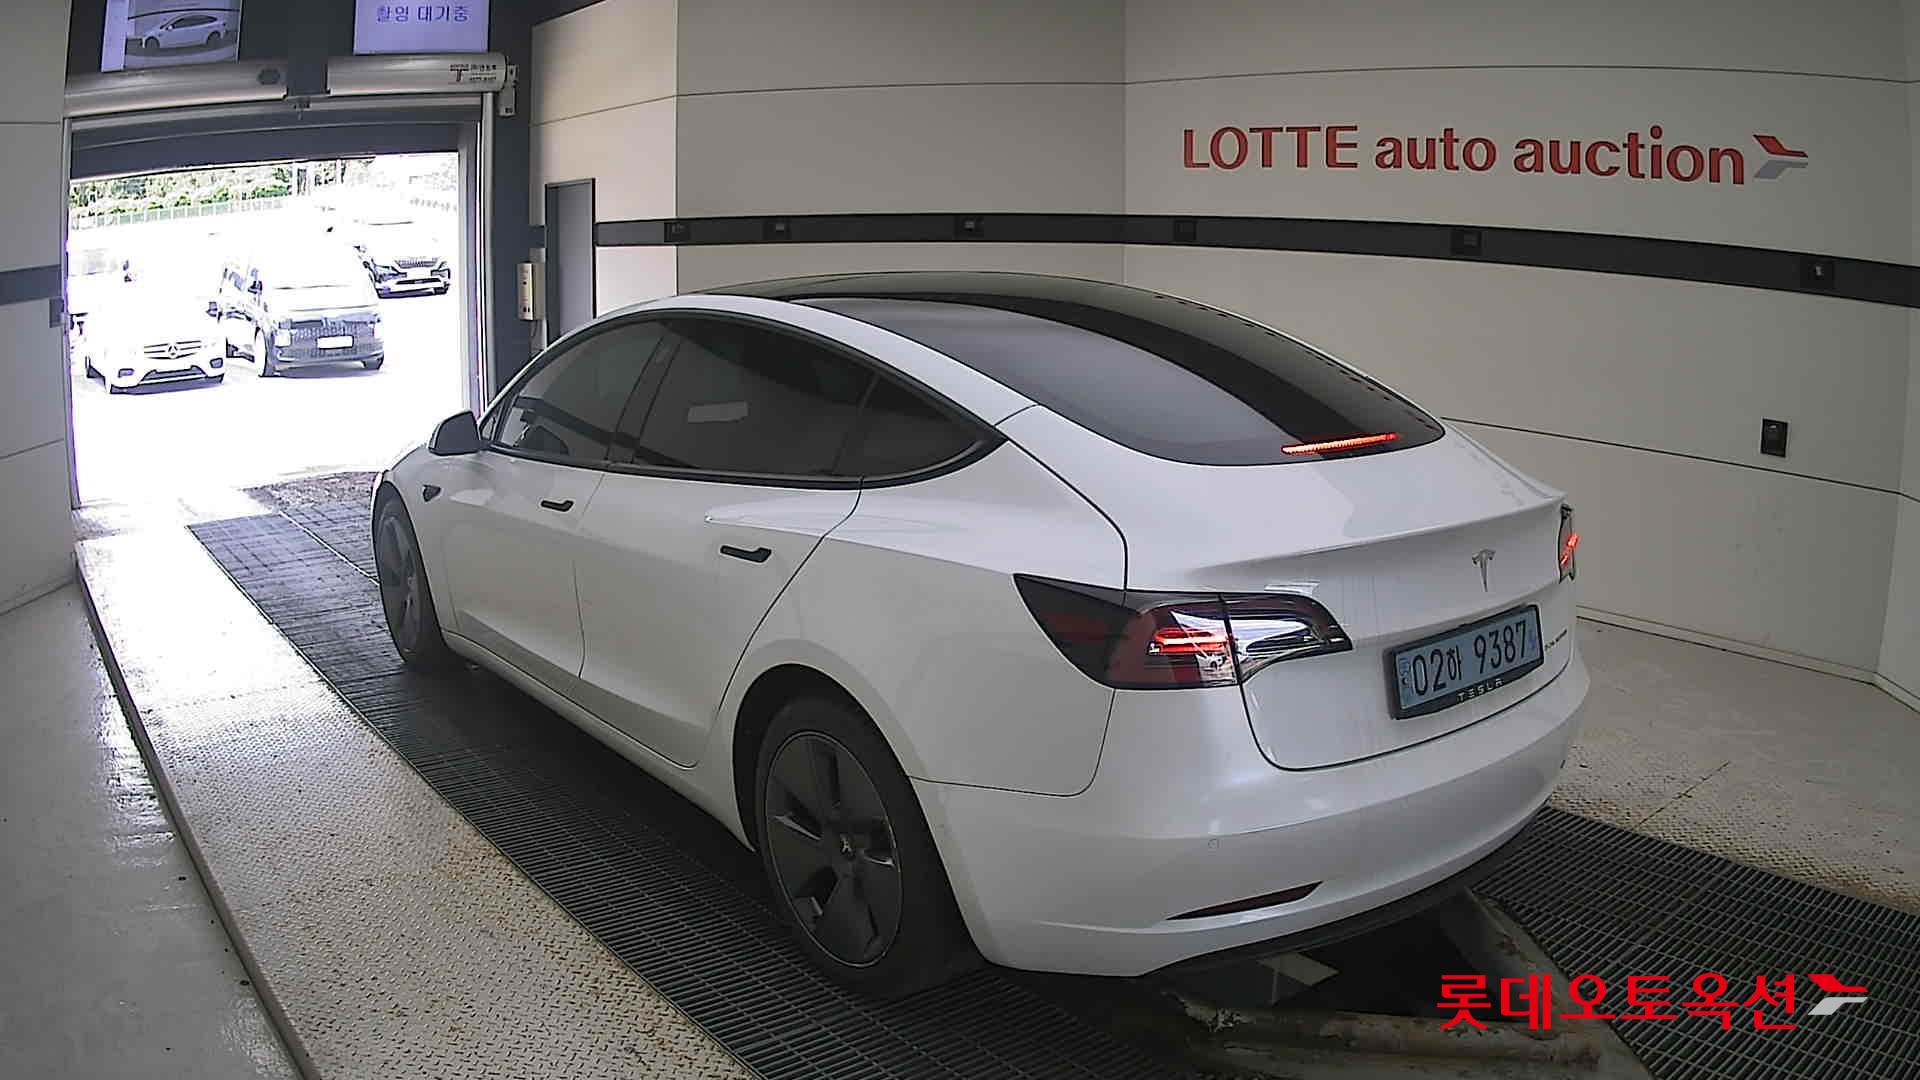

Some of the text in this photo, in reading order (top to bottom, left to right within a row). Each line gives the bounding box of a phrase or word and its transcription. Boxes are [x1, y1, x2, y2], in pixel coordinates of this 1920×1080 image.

[417, 5, 469, 22] 대기중
[1183, 125, 1745, 184] LOTTE auto auction
[1412, 645, 1463, 696] 02하
[1474, 620, 1526, 674] 9387
[1457, 678, 1504, 701] TESLA
